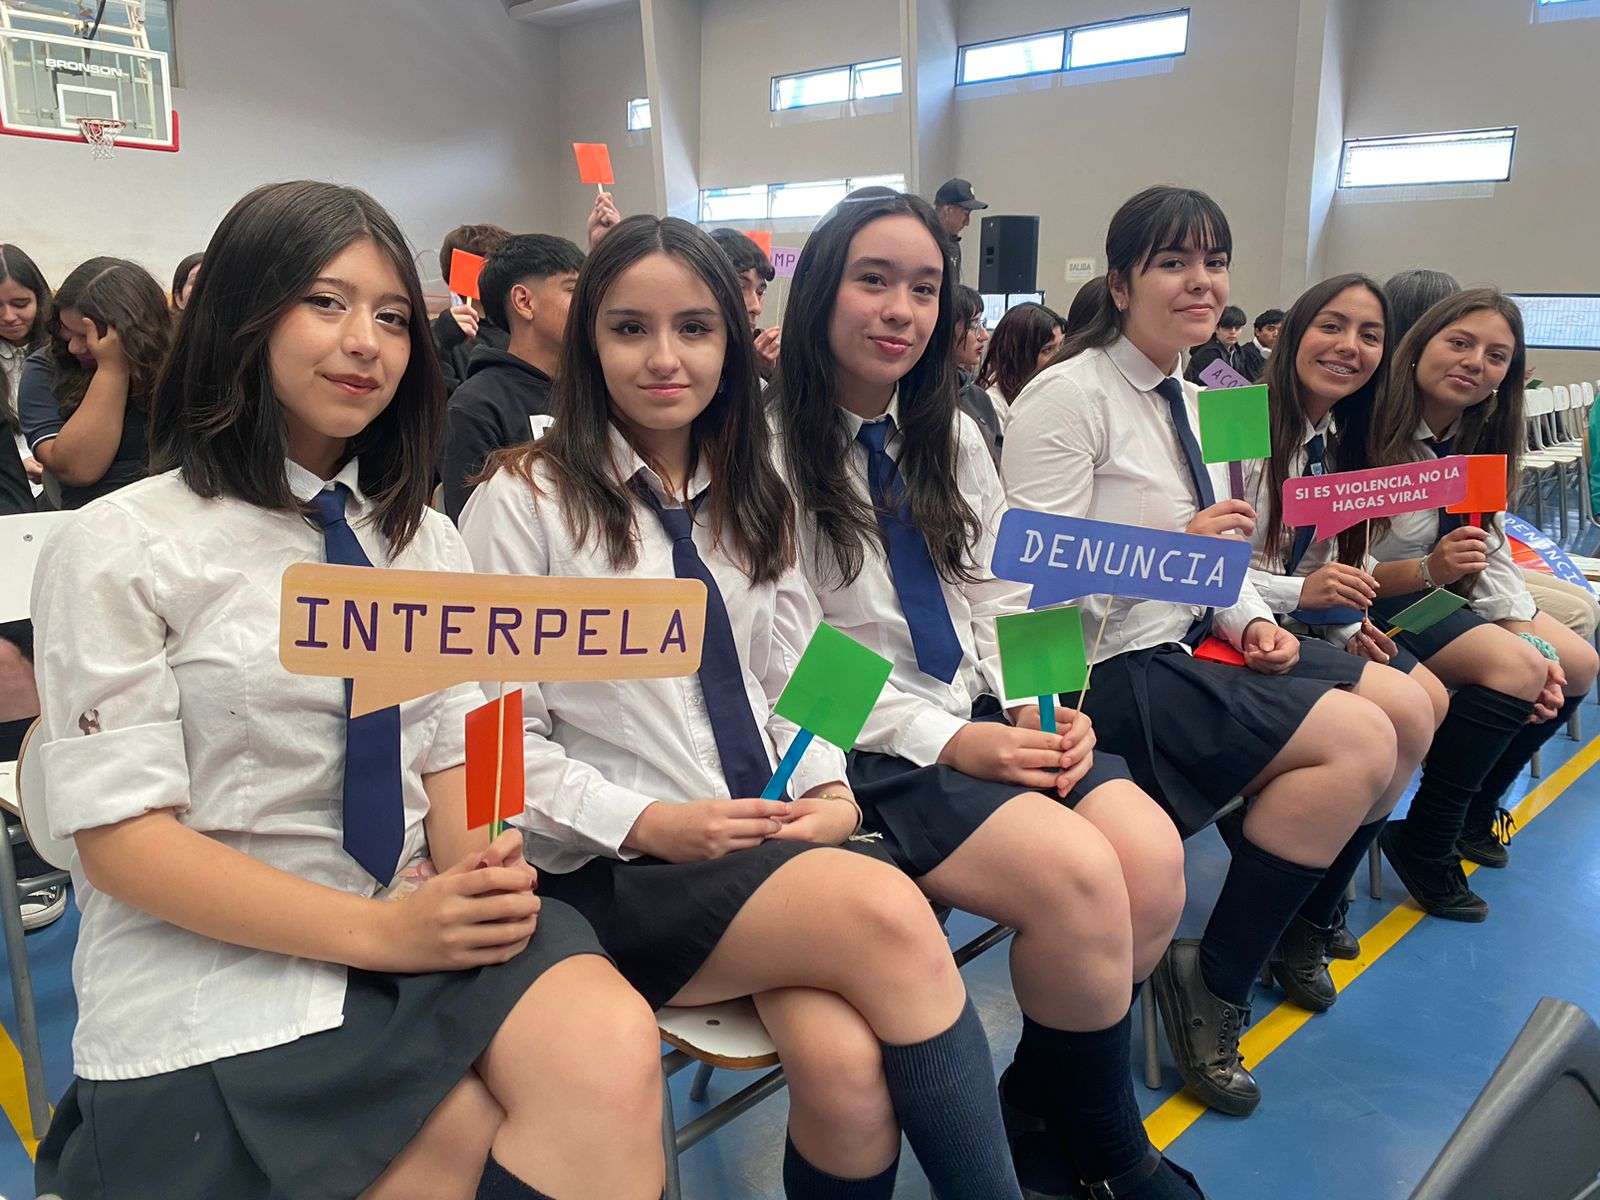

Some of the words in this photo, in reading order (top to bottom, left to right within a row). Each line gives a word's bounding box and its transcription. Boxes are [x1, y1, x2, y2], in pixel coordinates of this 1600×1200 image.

[45, 58, 123, 77] BRONSON
[1295, 488, 1309, 500] SI
[1314, 485, 1331, 498] ES
[1418, 470, 1441, 485] NO
[1444, 466, 1460, 480] LA
[1332, 494, 1385, 512] HAGAS
[1389, 488, 1429, 504] VIRAL
[1019, 529, 1225, 588] DENUNCIA
[294, 596, 688, 656] INTERPELA
